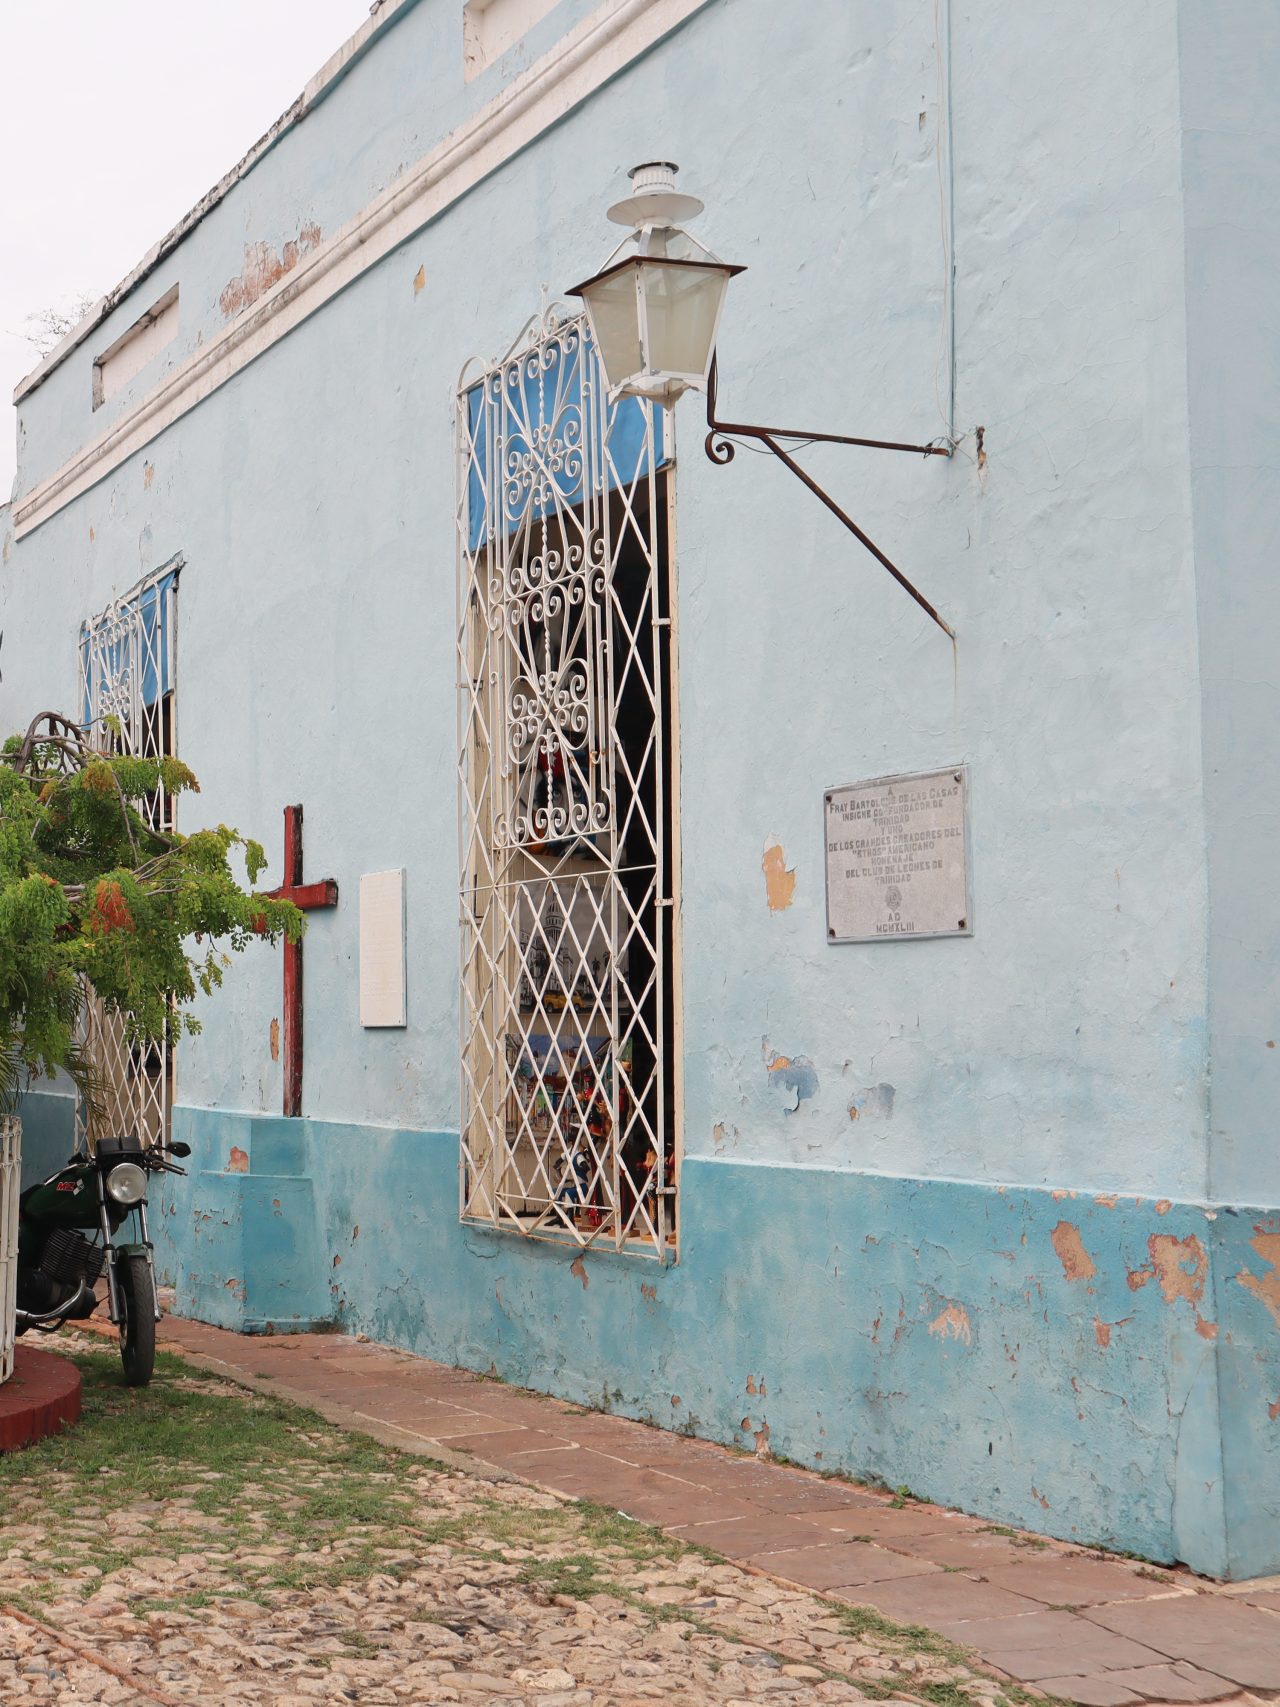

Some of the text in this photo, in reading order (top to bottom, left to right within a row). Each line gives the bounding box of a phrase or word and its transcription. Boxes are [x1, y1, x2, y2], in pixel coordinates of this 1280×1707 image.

[887, 786, 894, 796] A
[830, 803, 848, 814] FRAY
[899, 794, 909, 804] DE
[911, 791, 927, 802] LAS
[929, 786, 959, 799] CASAS
[842, 810, 871, 822] INSIGNE
[933, 799, 943, 808] DE
[873, 814, 910, 827] TRINIDAD
[881, 824, 904, 835] Y UNO
[829, 827, 962, 852] DE LOS GRANDES CREADORES DEL
[888, 841, 935, 854] AMERICANO
[871, 853, 914, 866] HOMENAJE
[845, 859, 943, 879] DEL CLUB DE LEONES DE
[875, 873, 912, 885] TRINIDAD
[876, 921, 915, 933] MCMXLIII
[56, 1181, 76, 1192] MZ
